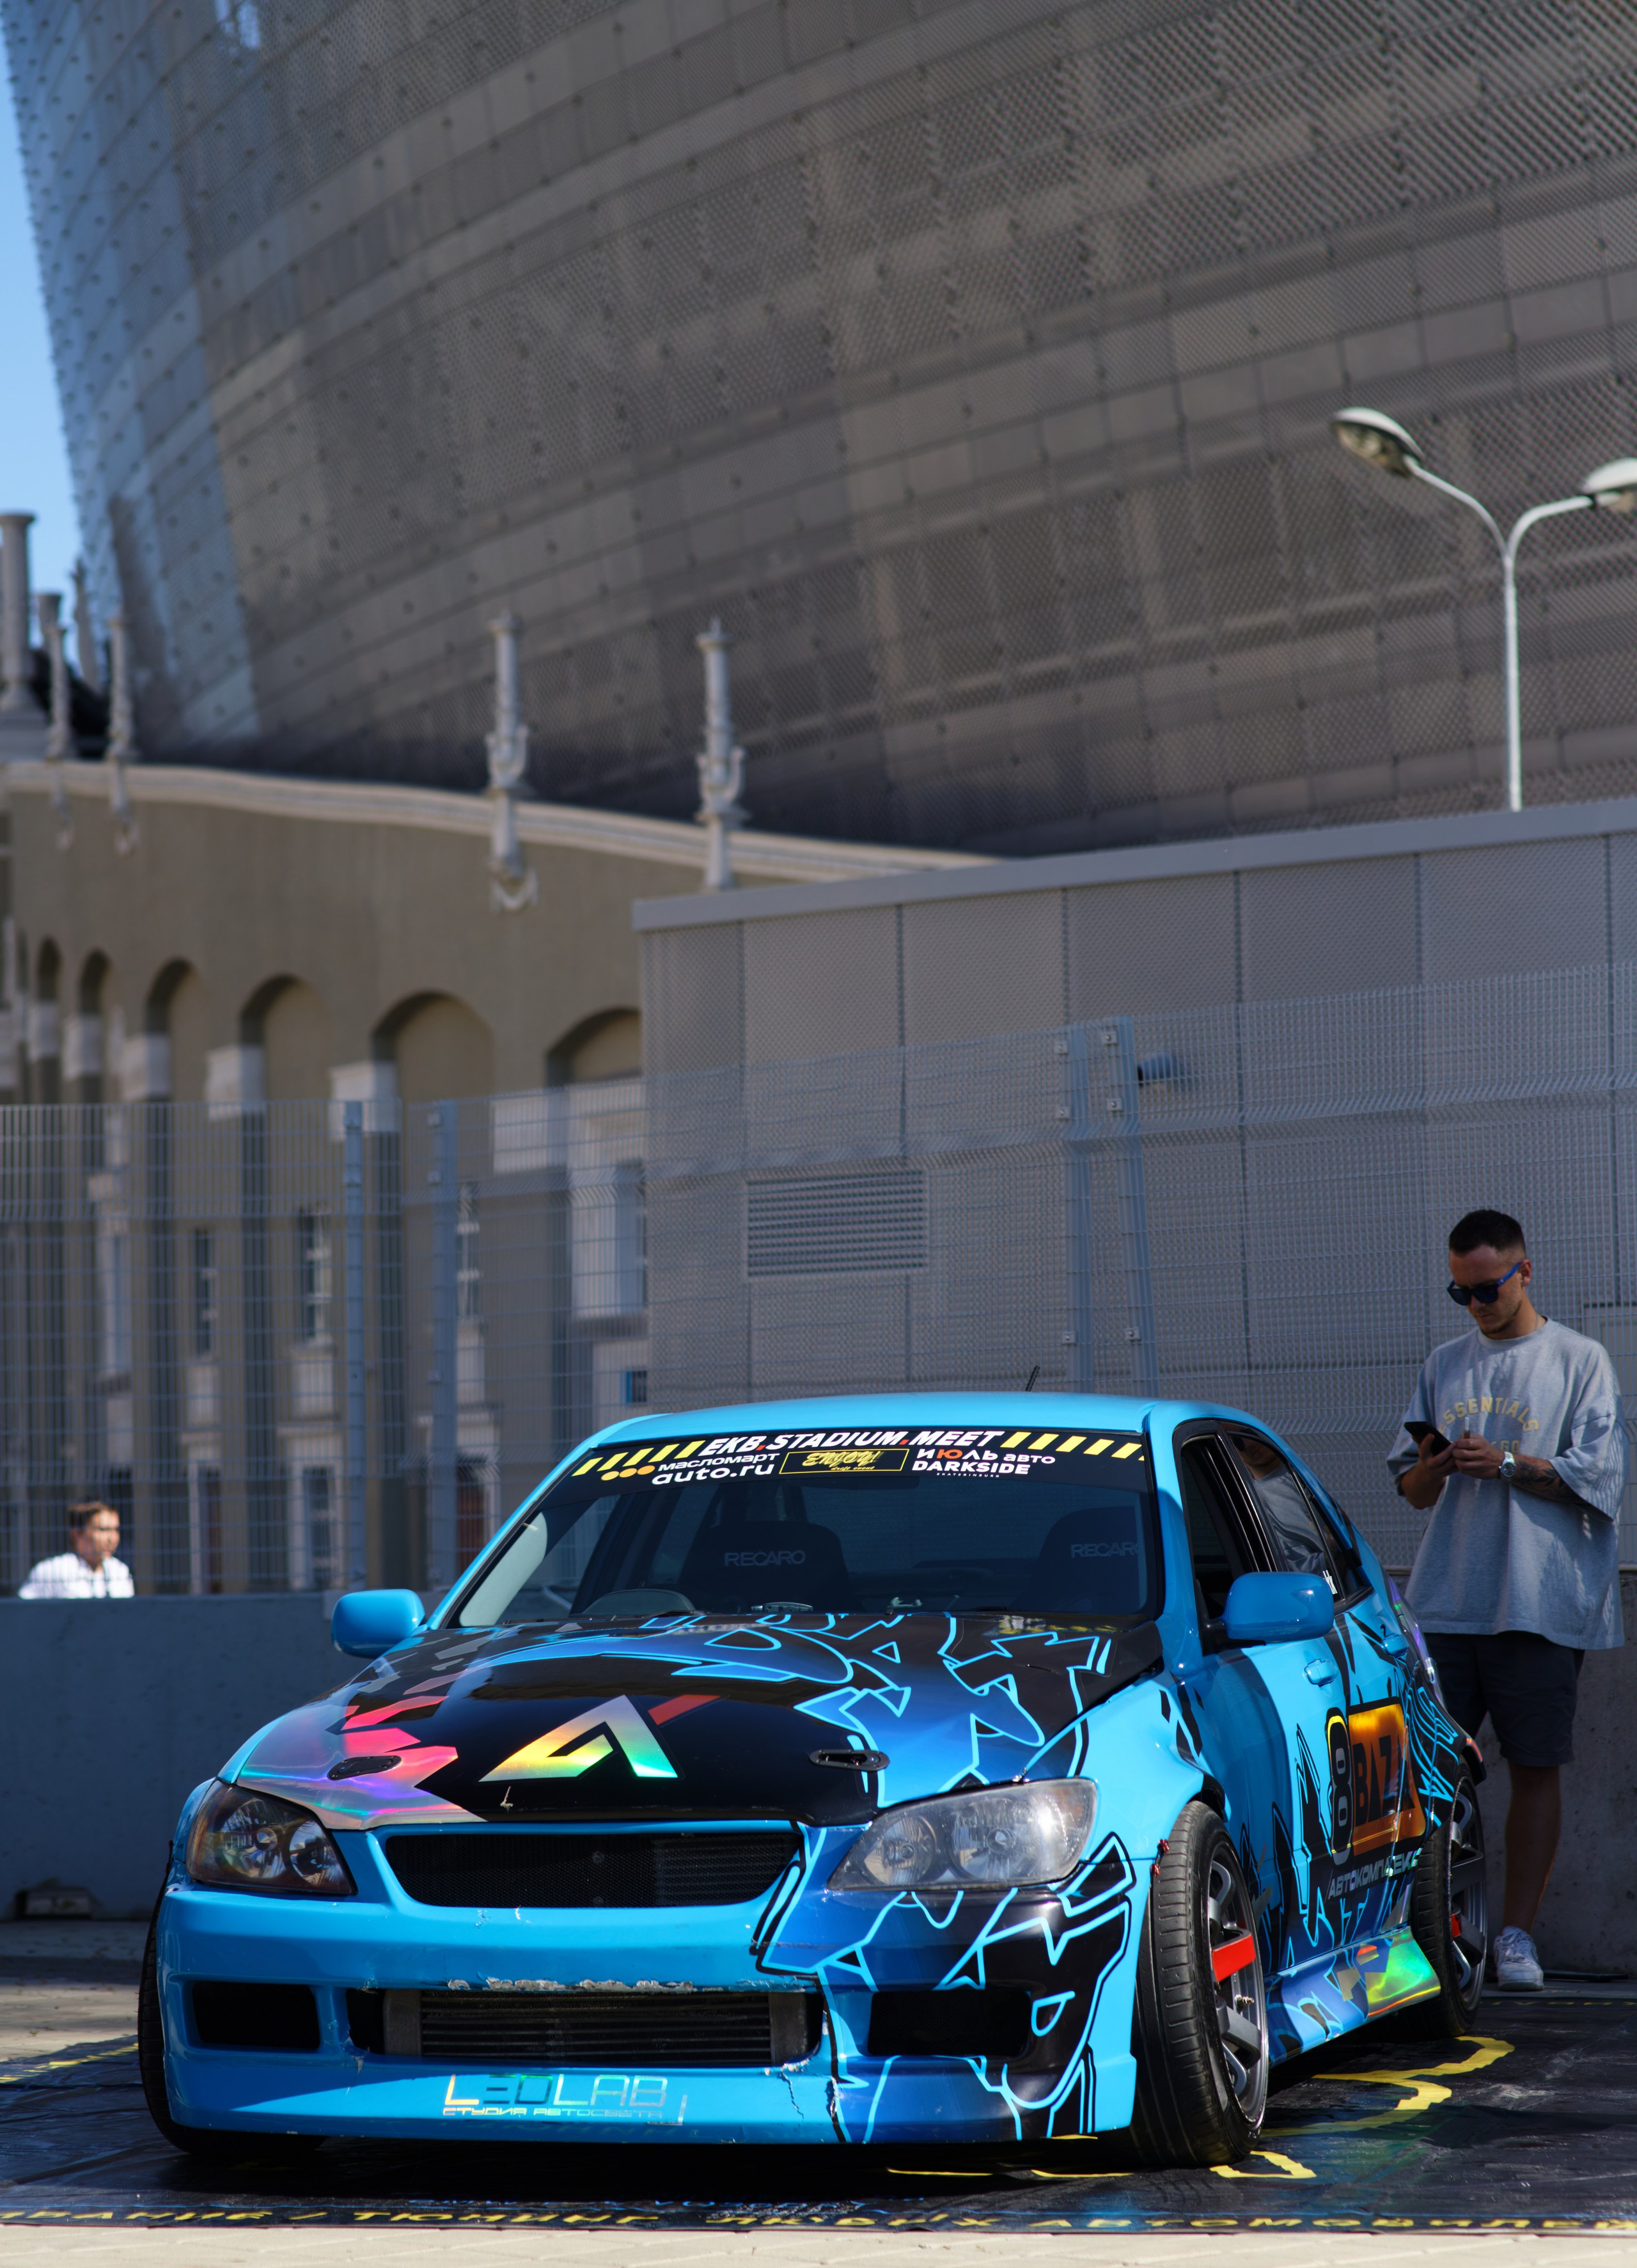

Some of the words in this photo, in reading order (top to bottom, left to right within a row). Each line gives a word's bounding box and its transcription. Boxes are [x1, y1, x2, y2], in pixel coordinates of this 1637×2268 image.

[657, 1452, 780, 1472] масломарт
[912, 1460, 1031, 1475] DARKSIDE
[651, 1464, 775, 1485] auto.ru
[1070, 1542, 1139, 1558] RECAR
[724, 1550, 807, 1567] RECARO
[443, 2108, 528, 2116] СТУДИЯ
